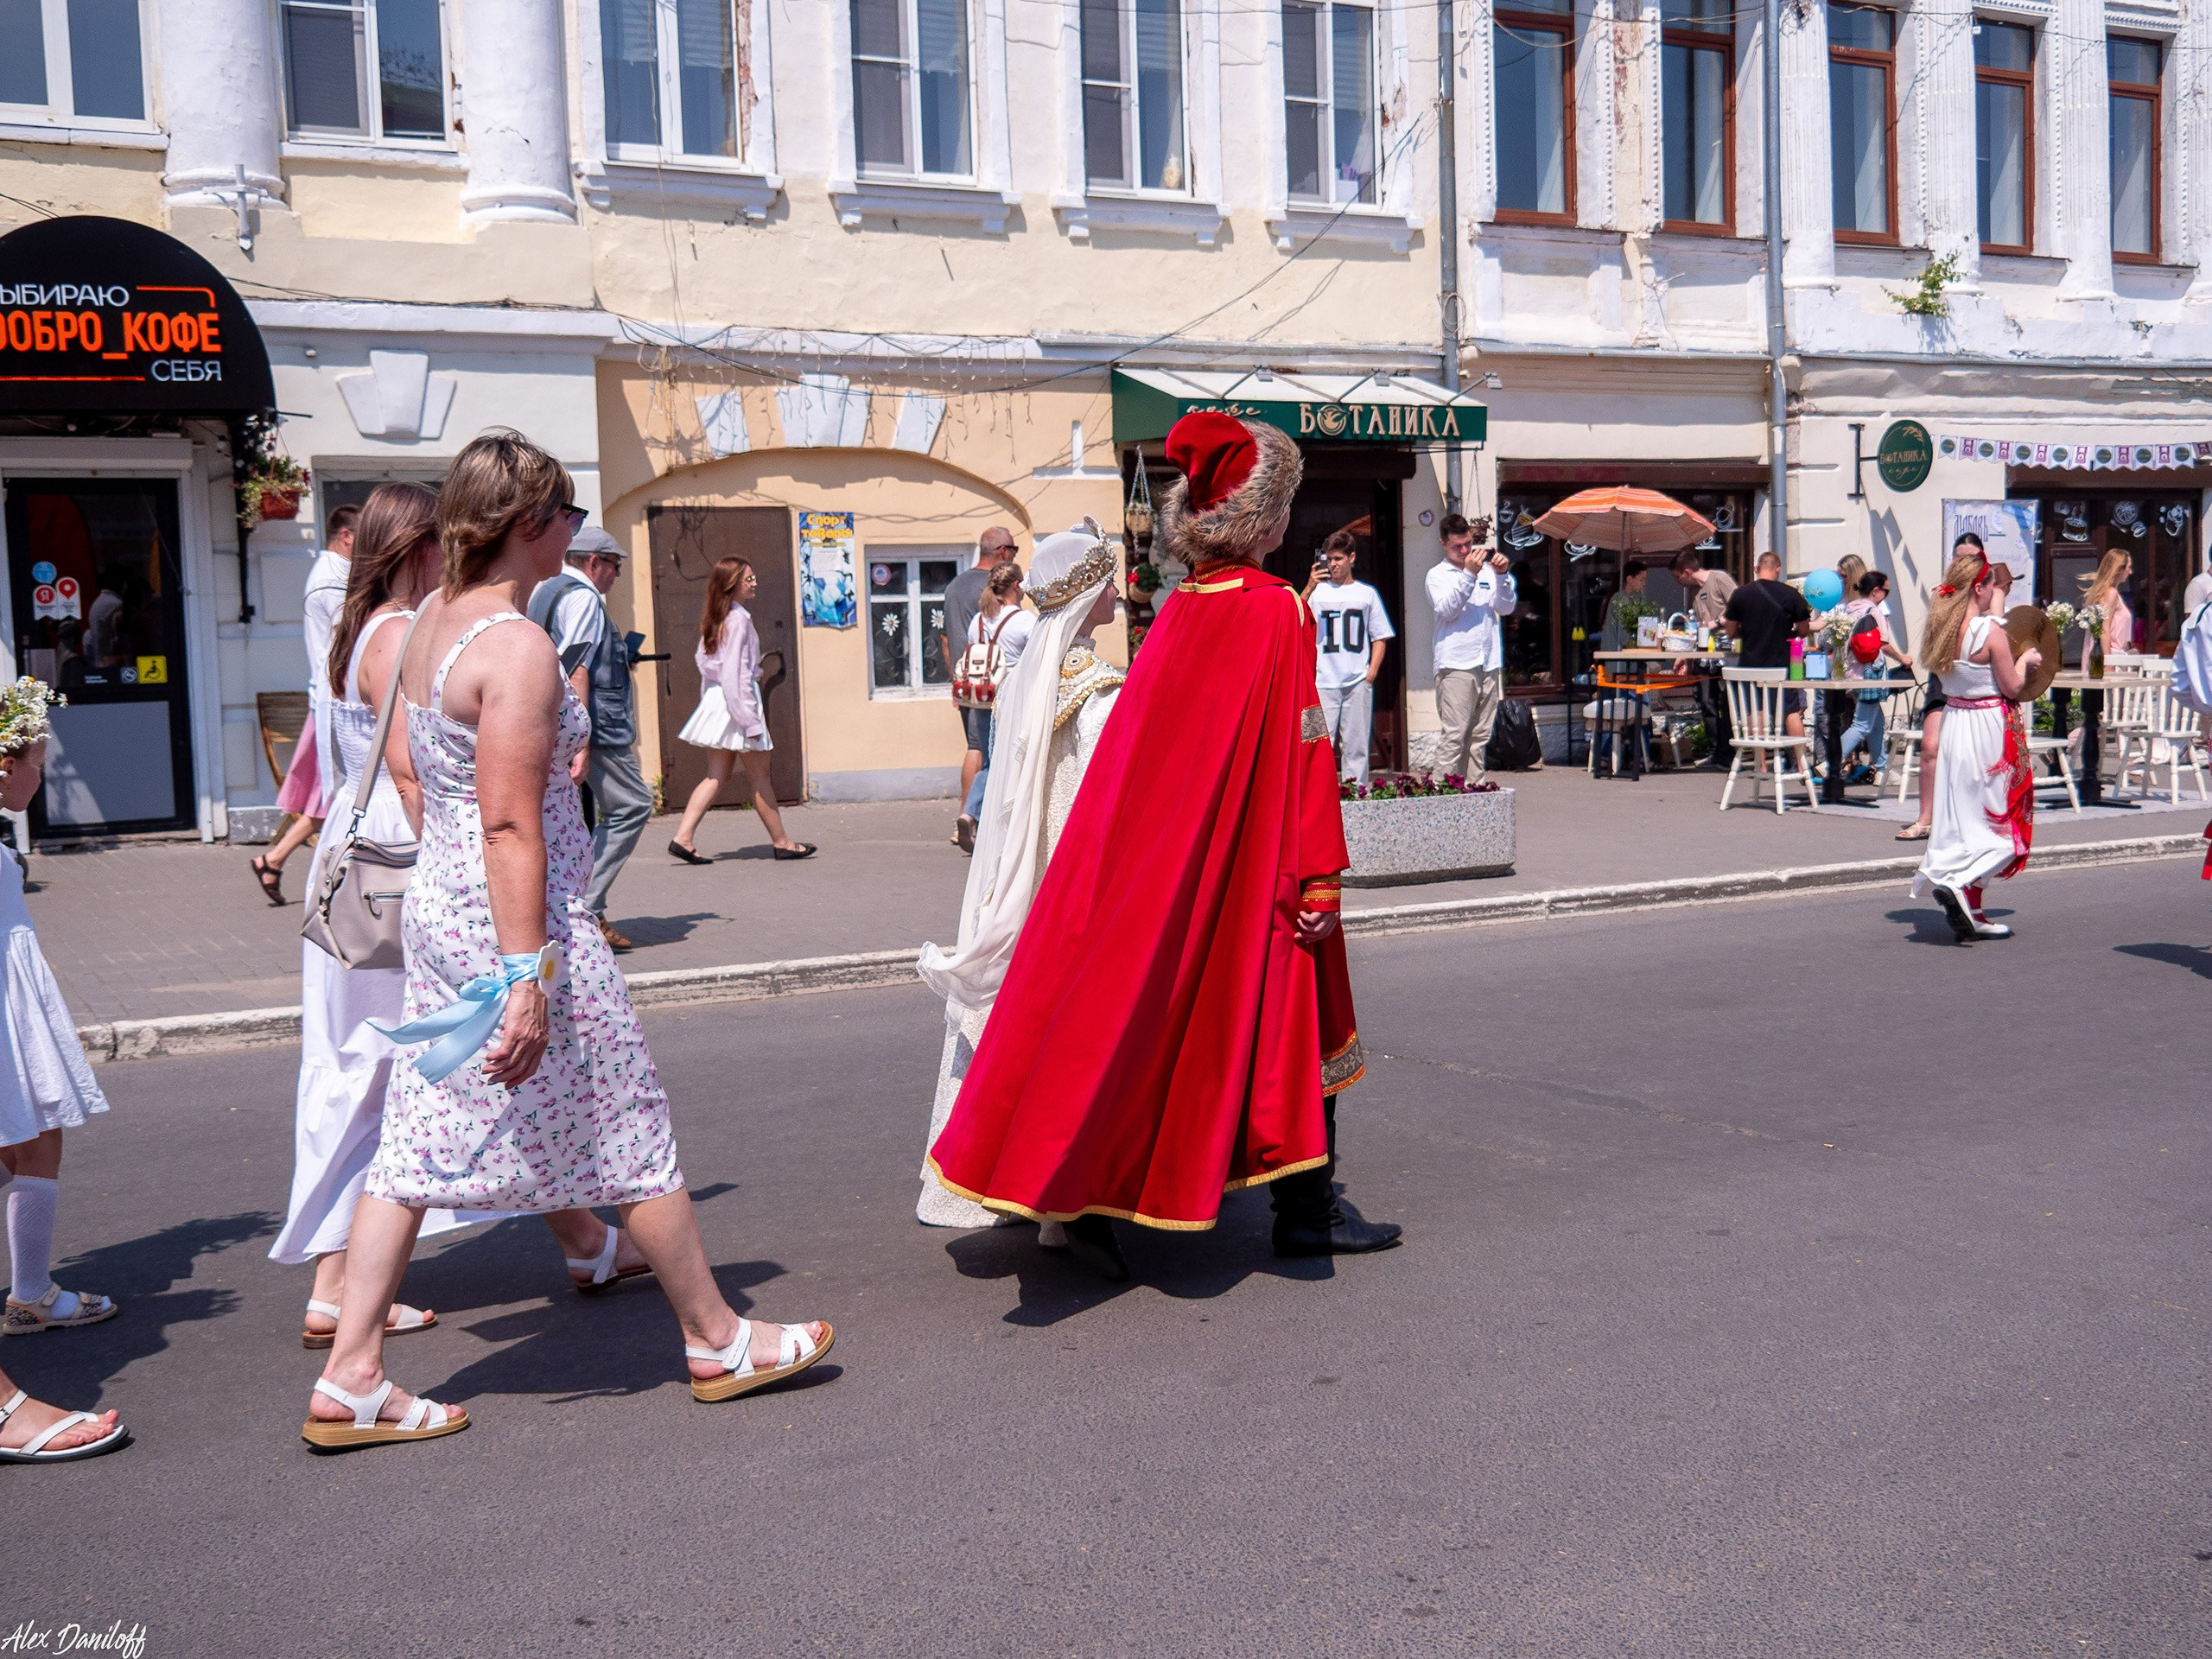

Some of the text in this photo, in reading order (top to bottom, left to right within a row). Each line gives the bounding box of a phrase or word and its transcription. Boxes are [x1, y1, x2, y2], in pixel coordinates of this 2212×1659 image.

[150, 359, 222, 381] СЕБЯ
[1300, 404, 1460, 437] БОТАНИКА
[1879, 450, 1927, 464] БОТАНИКА
[806, 514, 847, 526] Спорт
